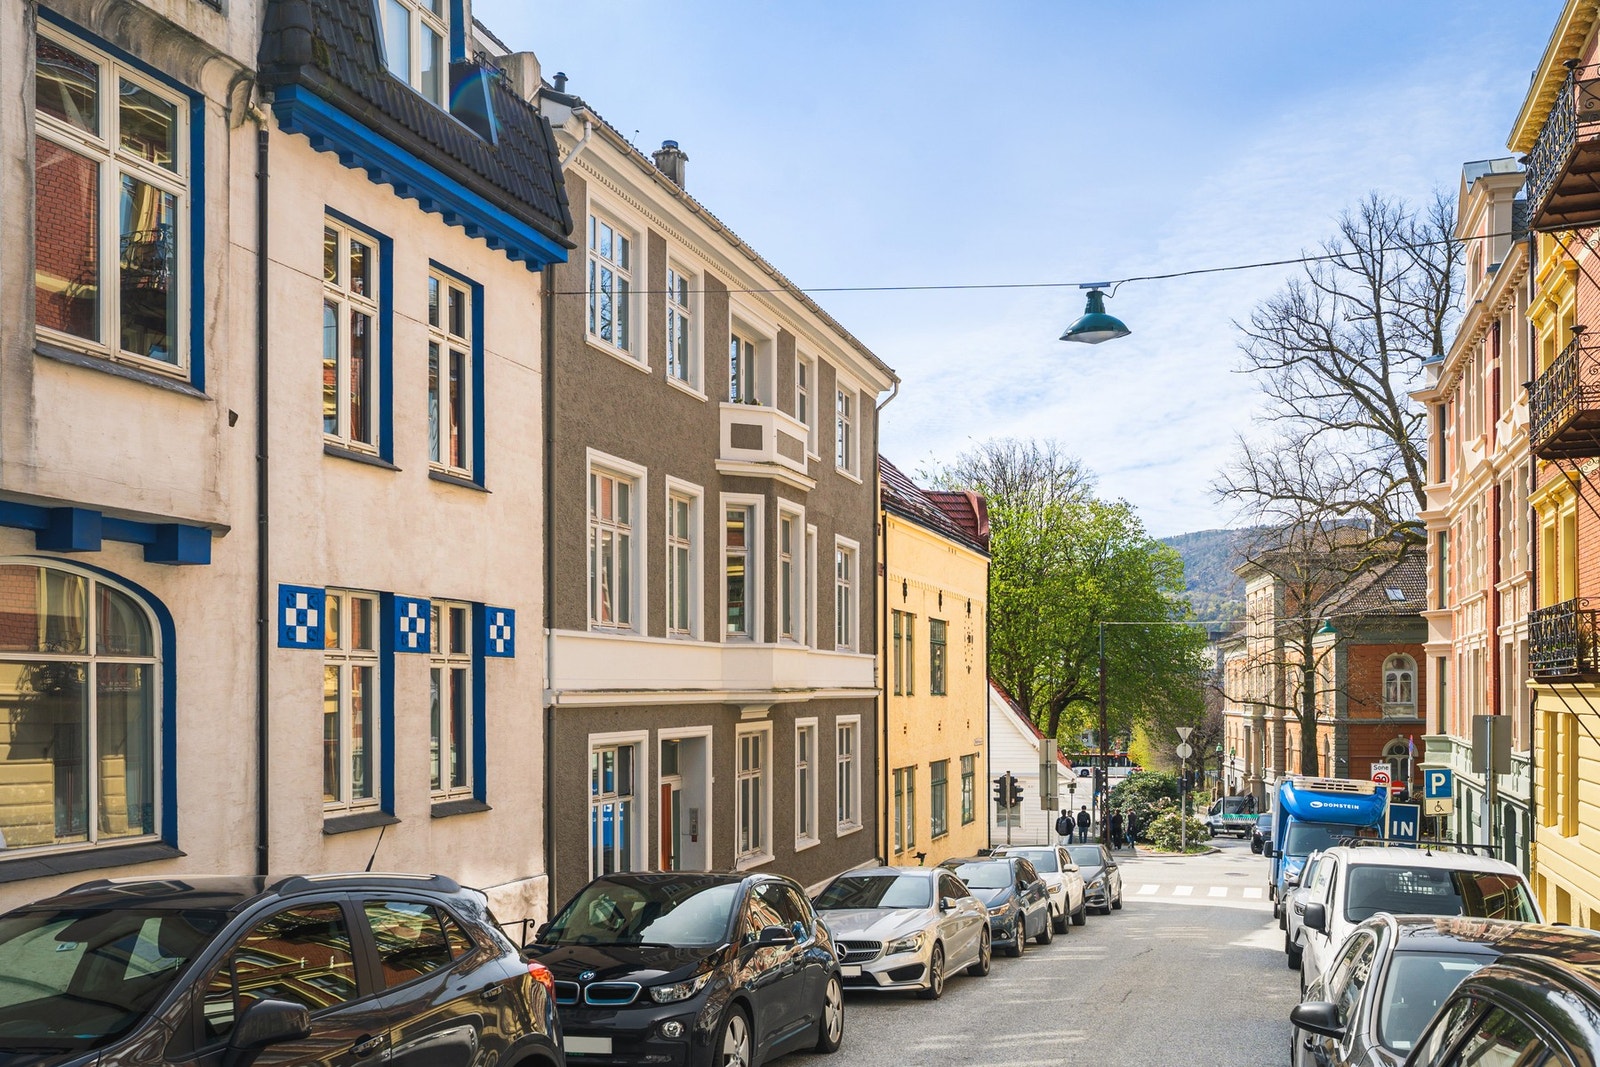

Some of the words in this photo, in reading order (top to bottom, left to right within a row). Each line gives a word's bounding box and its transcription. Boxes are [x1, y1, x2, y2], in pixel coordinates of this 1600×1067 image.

[1431, 772, 1446, 795] P
[1323, 802, 1360, 810] DOMSTEIN
[1392, 820, 1414, 837] IN
